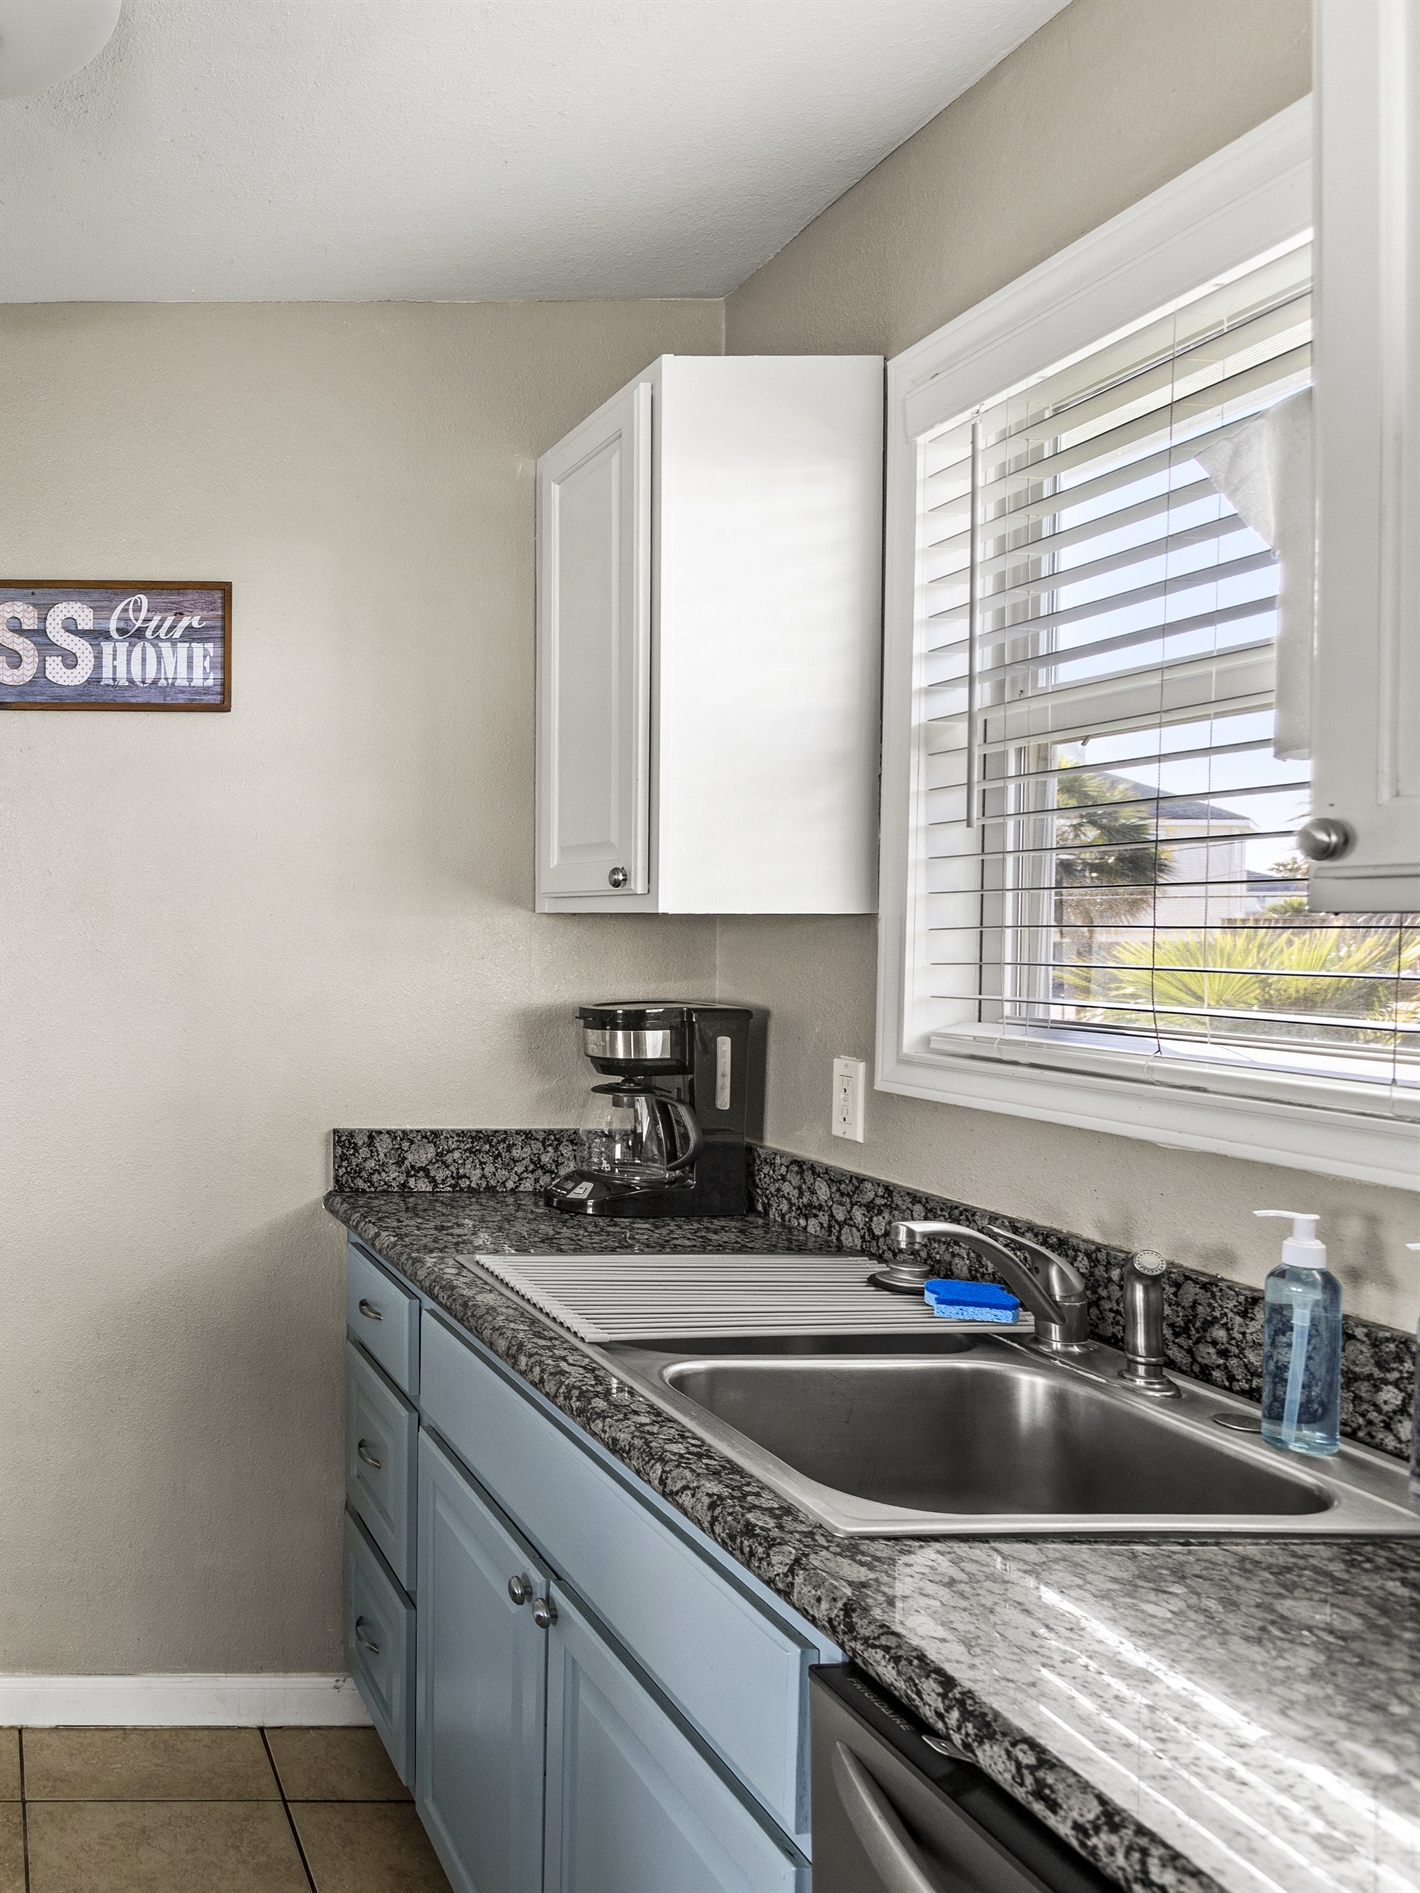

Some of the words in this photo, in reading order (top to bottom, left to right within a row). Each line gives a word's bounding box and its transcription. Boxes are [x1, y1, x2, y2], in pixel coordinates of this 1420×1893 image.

[108, 594, 207, 641] Our
[99, 641, 215, 687] HOME
[847, 1678, 915, 1731] FRIGIDAIRE
